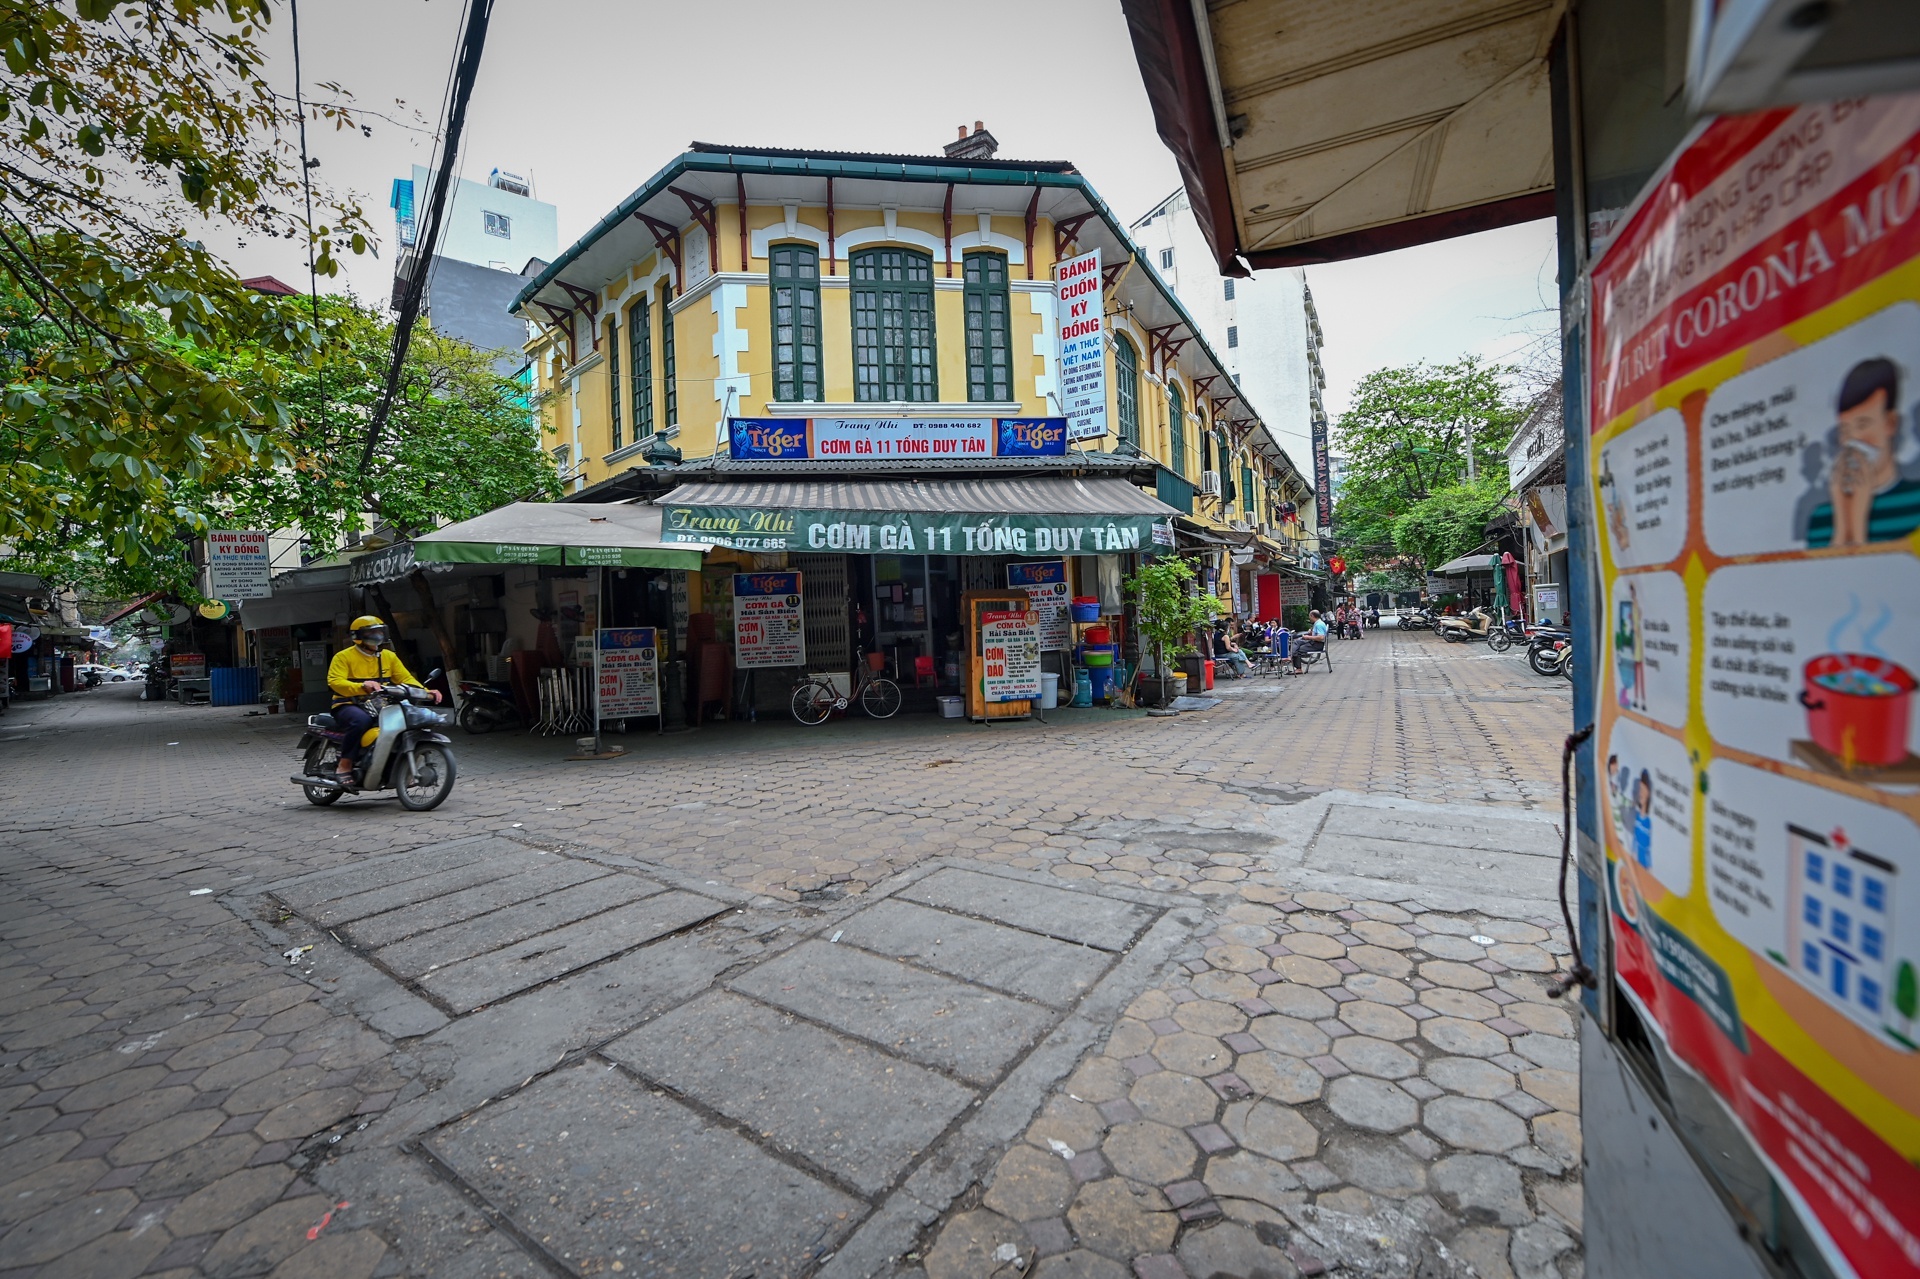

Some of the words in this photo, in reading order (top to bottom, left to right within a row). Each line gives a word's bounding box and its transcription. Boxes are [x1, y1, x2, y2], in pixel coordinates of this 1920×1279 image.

[1060, 257, 1097, 281] BÁNH
[1060, 276, 1097, 300] CUỐN
[1674, 229, 1836, 349] CORONA
[1082, 349, 1101, 361] NAM
[835, 420, 870, 431] Trang
[875, 420, 899, 430] Nhi
[748, 427, 804, 457] Tiger
[1013, 421, 1064, 450] Tiger
[821, 438, 850, 454] CƠM
[855, 437, 873, 454] GÀ
[876, 439, 891, 453] 11
[896, 434, 929, 454] TỐNG
[933, 439, 957, 453] DUY
[961, 436, 985, 453] TÂN
[670, 508, 741, 534] Trang
[748, 511, 794, 532] Nhi
[211, 532, 237, 543] BÁNH
[240, 531, 265, 543] CUỐN
[808, 521, 870, 549] CƠM
[880, 519, 916, 550] GÀ
[923, 526, 951, 551] 11
[962, 518, 1027, 552] TỐNG
[1035, 527, 1083, 552] DUY
[1091, 522, 1140, 551] TÂN
[736, 537, 760, 549] 077
[763, 538, 786, 549] 665
[1023, 565, 1056, 582] Tiger
[751, 575, 788, 593] Tiger
[1056, 584, 1065, 592] 11
[771, 600, 784, 608] GÀ
[788, 596, 798, 604] 11
[1026, 612, 1036, 621] 11
[738, 622, 758, 633] CƠM
[996, 622, 1014, 630] CƠM
[1015, 621, 1027, 629] GÀ
[611, 631, 645, 647] Tiger
[985, 646, 1004, 660] CƠM
[987, 662, 1003, 677] ĐẢO
[600, 674, 617, 685] CƠM
